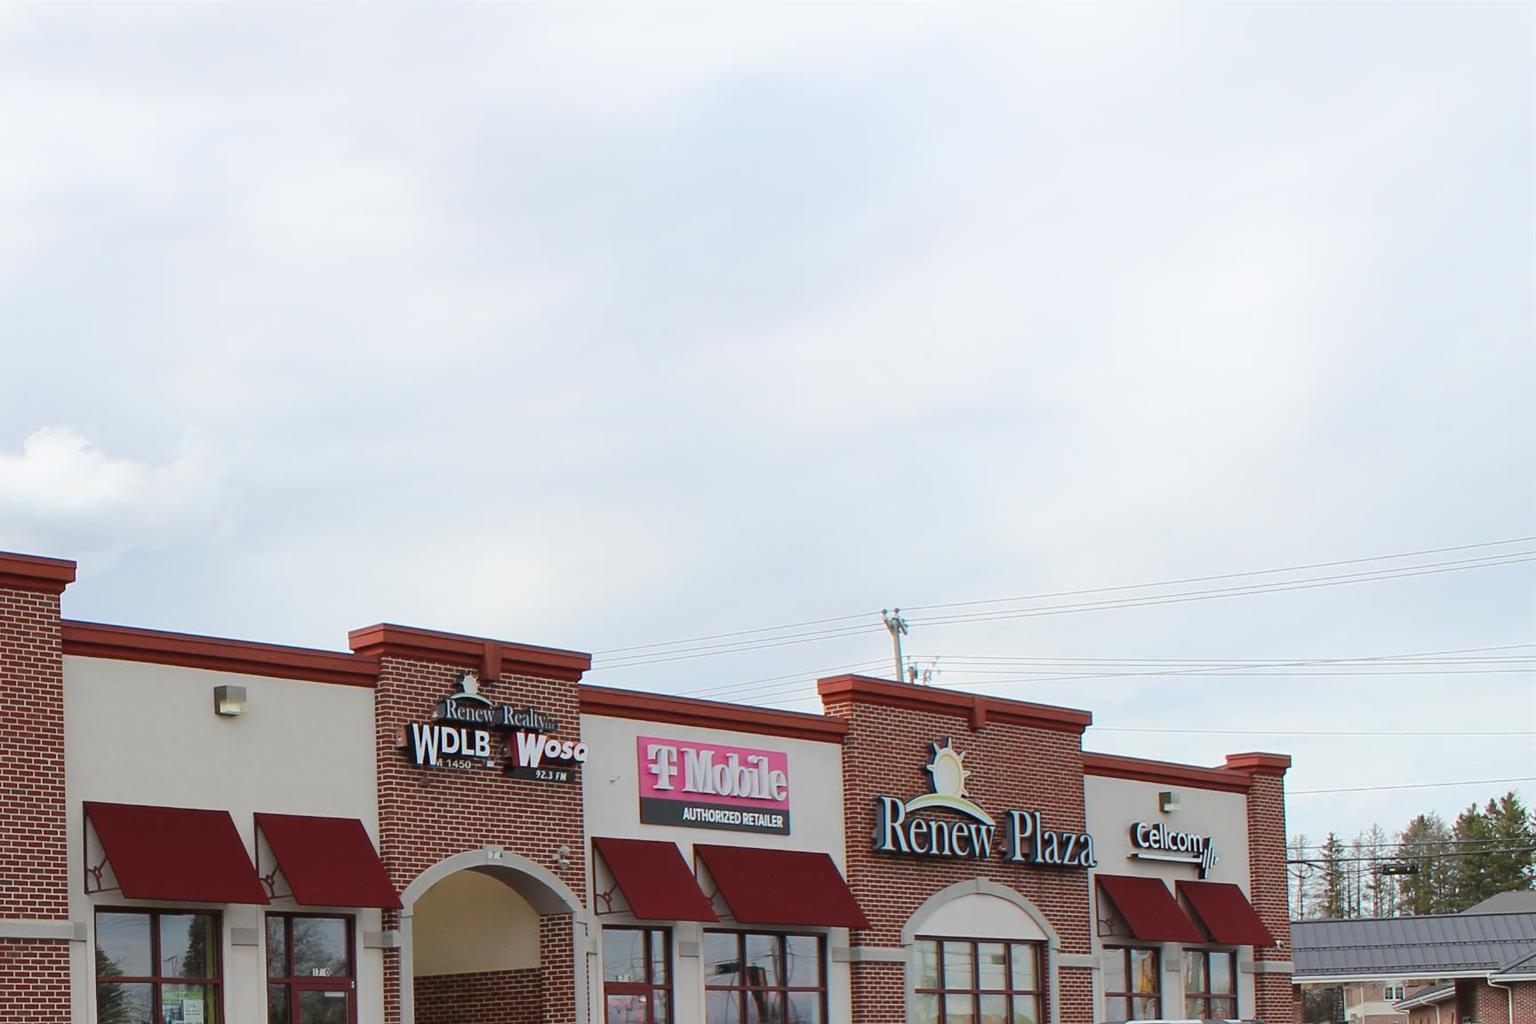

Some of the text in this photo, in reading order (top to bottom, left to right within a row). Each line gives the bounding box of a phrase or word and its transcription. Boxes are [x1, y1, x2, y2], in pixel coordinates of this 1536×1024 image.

[445, 699, 495, 723] Renew
[503, 705, 545, 730] Realty
[412, 723, 491, 766] WDLB
[446, 759, 472, 769] 1450
[535, 769, 567, 781] 92.3 FM
[683, 806, 784, 828] AUTHORIZED RETAILER
[880, 796, 1098, 868] Renew Plaza
[1135, 821, 1204, 853] Cellcom
